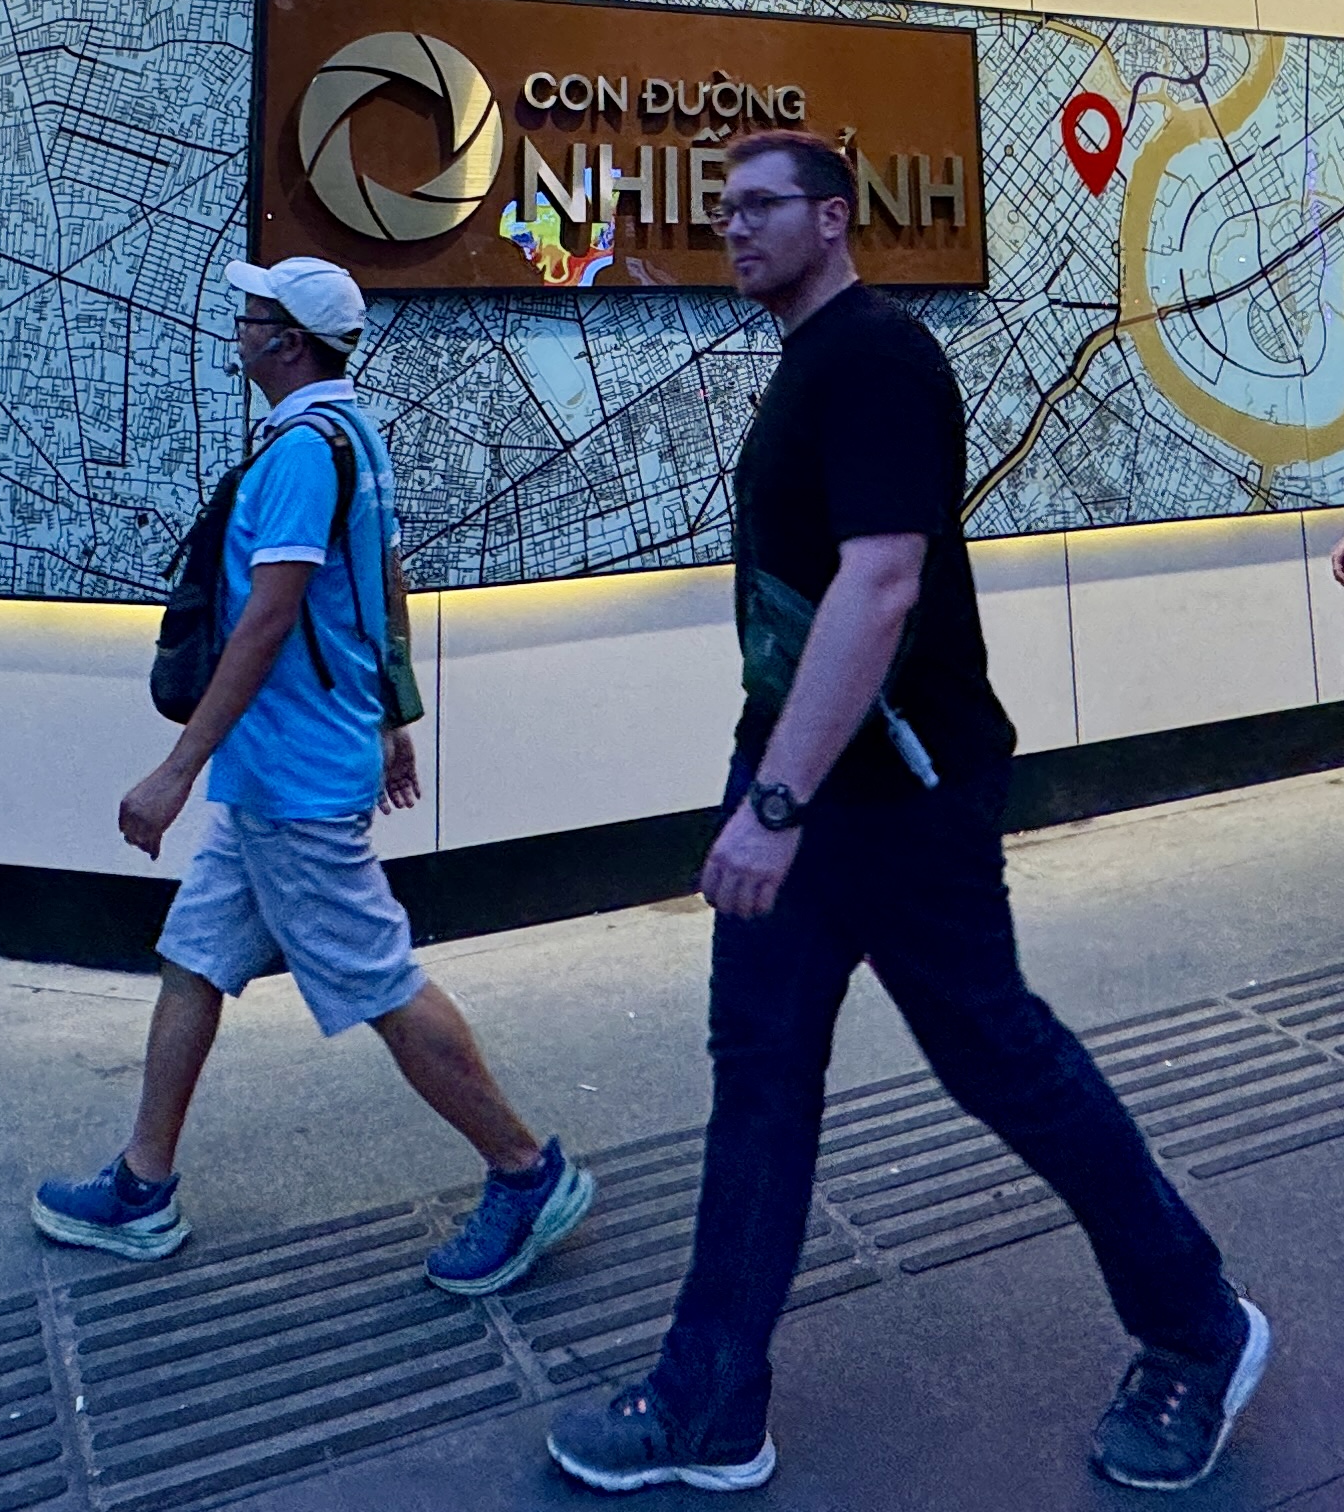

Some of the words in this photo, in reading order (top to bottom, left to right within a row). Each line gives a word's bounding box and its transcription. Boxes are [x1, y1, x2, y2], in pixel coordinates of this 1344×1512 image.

[524, 72, 628, 112] CON
[641, 70, 806, 122] ĐƯỜNG
[524, 124, 732, 224] NHIẾ
